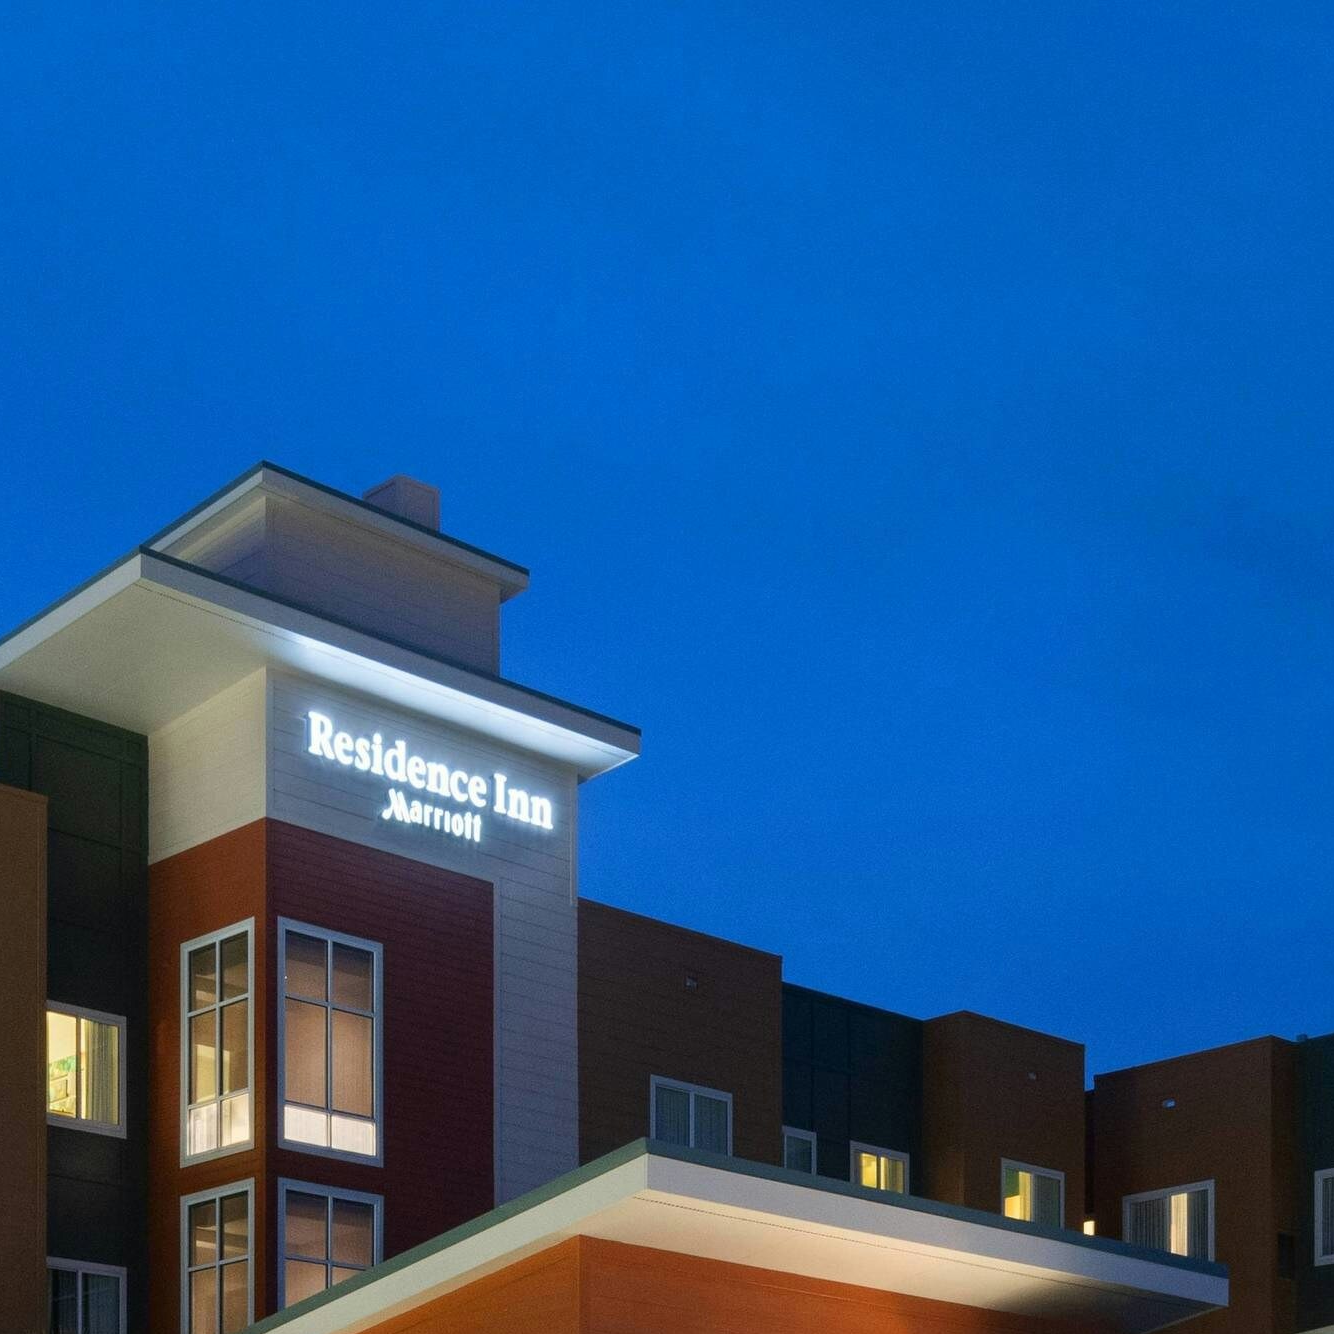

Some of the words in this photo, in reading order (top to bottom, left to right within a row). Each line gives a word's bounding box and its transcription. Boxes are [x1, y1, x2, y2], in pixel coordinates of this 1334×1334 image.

[307, 711, 487, 808] Residence
[493, 773, 553, 829] Inn
[382, 788, 482, 842] Marriott
